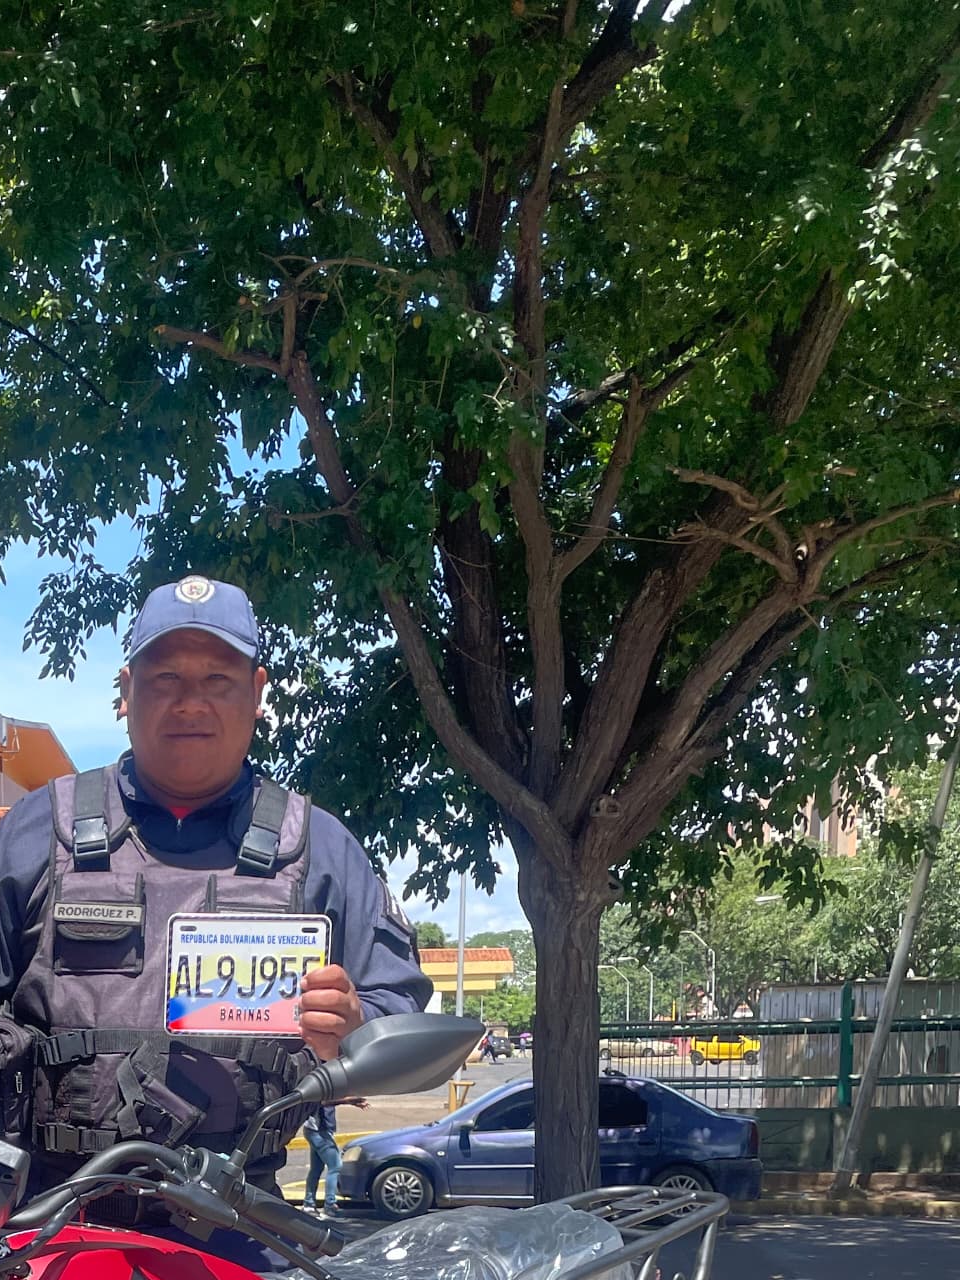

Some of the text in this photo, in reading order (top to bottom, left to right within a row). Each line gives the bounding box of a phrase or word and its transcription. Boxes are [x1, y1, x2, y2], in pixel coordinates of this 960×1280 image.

[57, 906, 137, 919] RODRIGUEZ P.
[180, 934, 317, 945] REPUBLICA BOLIVARIANA DE VENEZUELA
[220, 1008, 271, 1022] BARINAS
